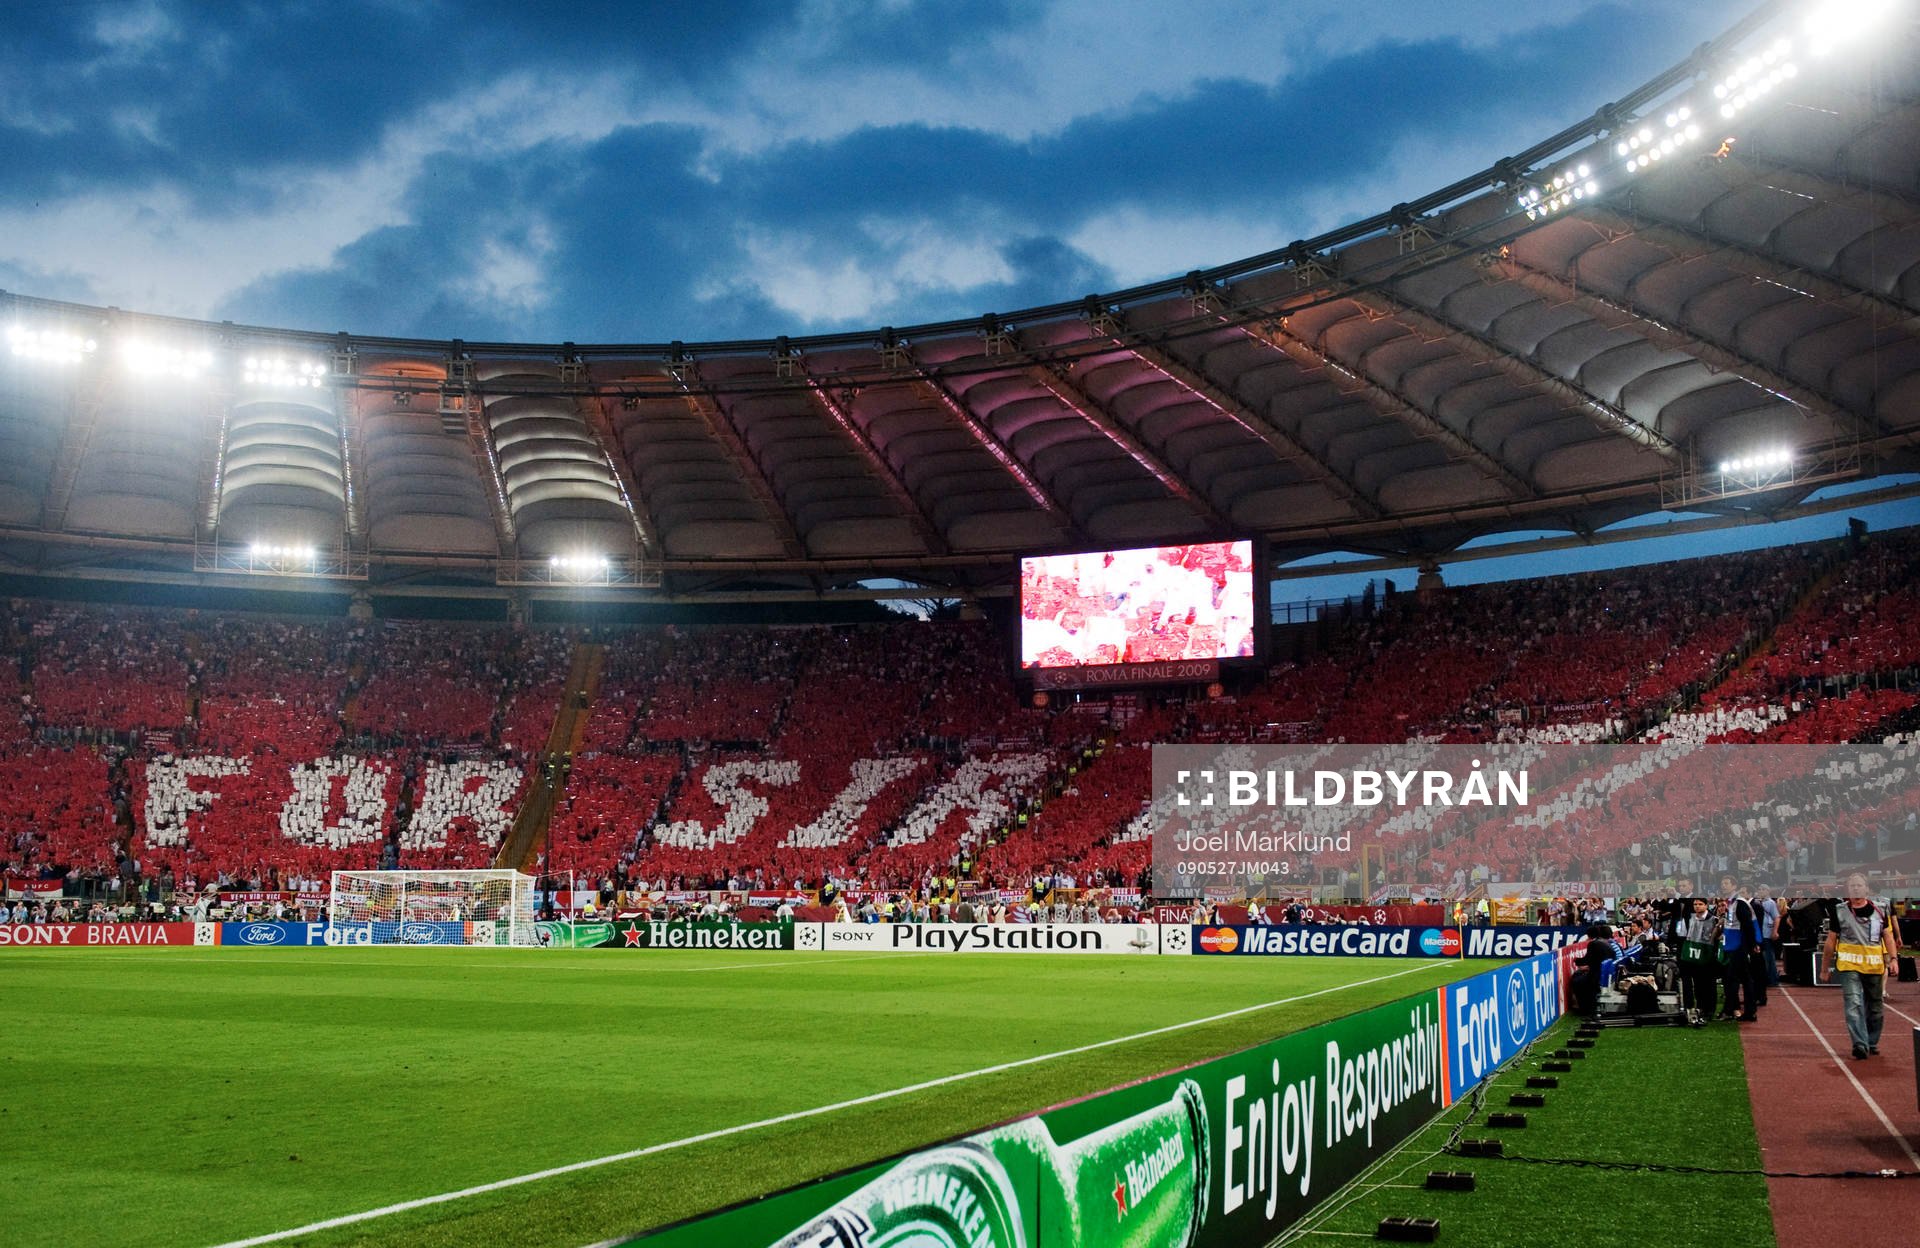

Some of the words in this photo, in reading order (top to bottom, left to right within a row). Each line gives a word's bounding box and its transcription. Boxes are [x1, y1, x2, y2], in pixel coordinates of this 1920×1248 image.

[1086, 669, 1128, 682] ROMA
[1131, 666, 1173, 680] FINALE
[1177, 663, 1211, 677] 2009
[1170, 888, 1200, 897] ARMY
[1160, 908, 1189, 922] FINA
[0, 925, 76, 945] SONY
[88, 925, 169, 944] BRAVIA
[248, 926, 276, 941] Ford
[307, 922, 372, 945] Ford
[648, 922, 783, 949] Heineken
[832, 932, 875, 941] SONY
[893, 924, 1102, 952] PlayStation
[1200, 935, 1238, 944] MasterCard
[1243, 927, 1410, 955] MasterCard
[1424, 938, 1458, 946] Maestro
[1688, 947, 1702, 959] TV
[1511, 978, 1525, 1031] Ford
[1532, 958, 1556, 1031] Ford
[1456, 975, 1501, 1087] Ford
[1224, 1058, 1316, 1221] Enjoy
[1326, 1002, 1438, 1148] Responsibly
[1124, 1132, 1185, 1209] Heineken
